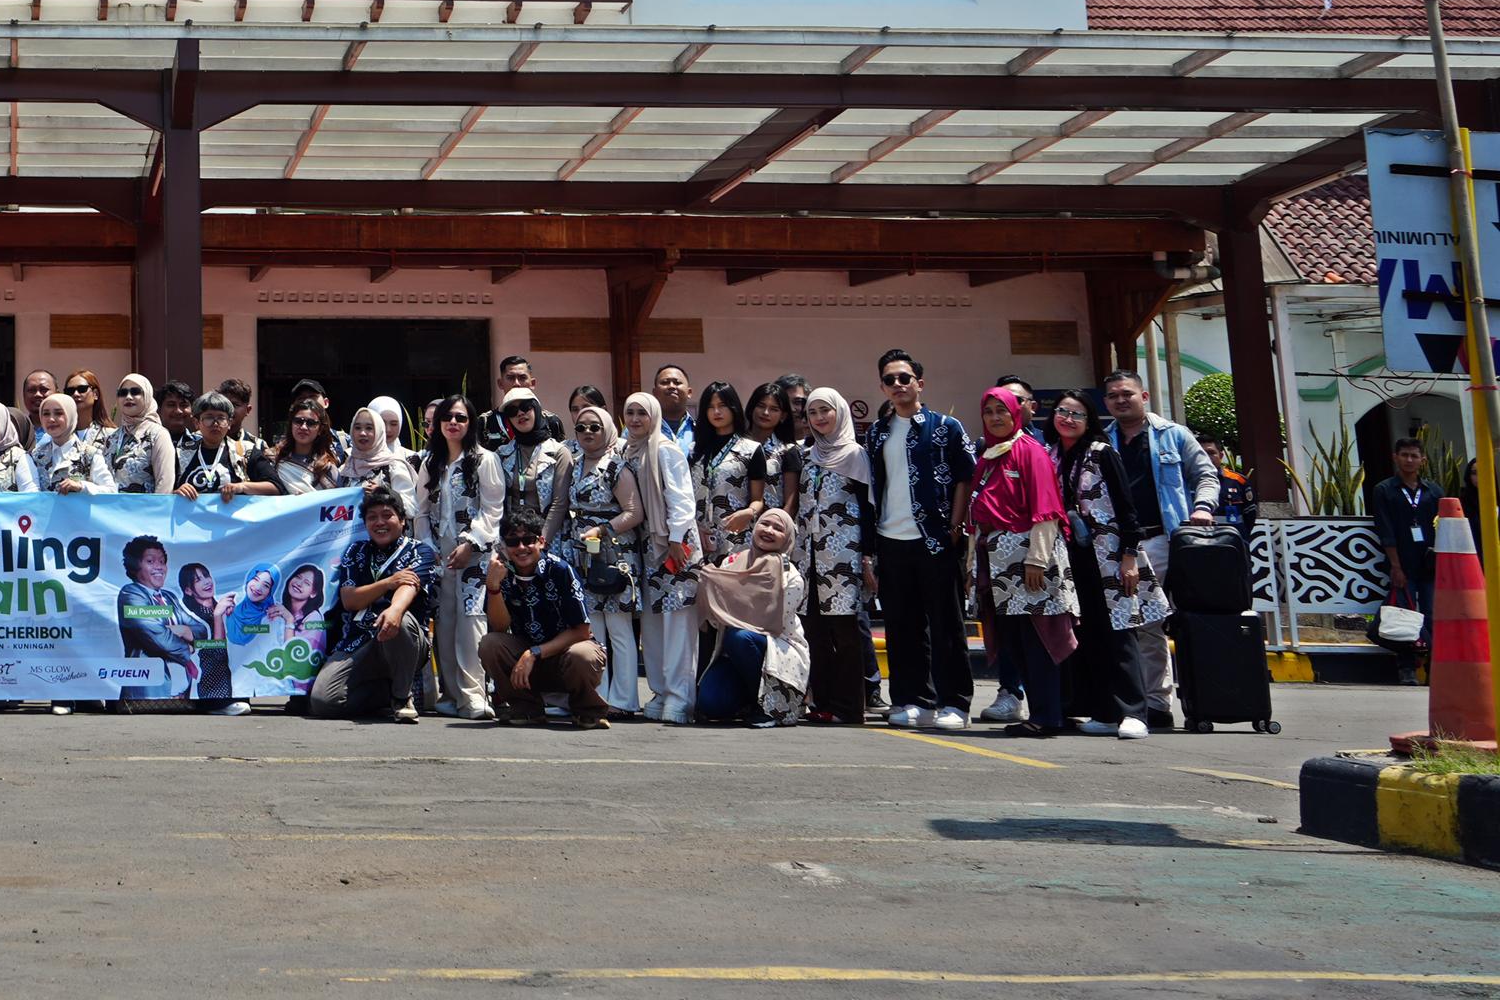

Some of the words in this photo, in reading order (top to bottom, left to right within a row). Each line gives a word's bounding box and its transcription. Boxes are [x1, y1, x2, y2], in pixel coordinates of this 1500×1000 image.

[319, 504, 355, 522] KAI
[139, 607, 170, 616] Purwoto
[12, 642, 56, 650] KUNINGAN
[30, 665, 44, 673] MS
[44, 665, 71, 674] GLOW
[111, 669, 150, 680] FUELIN
